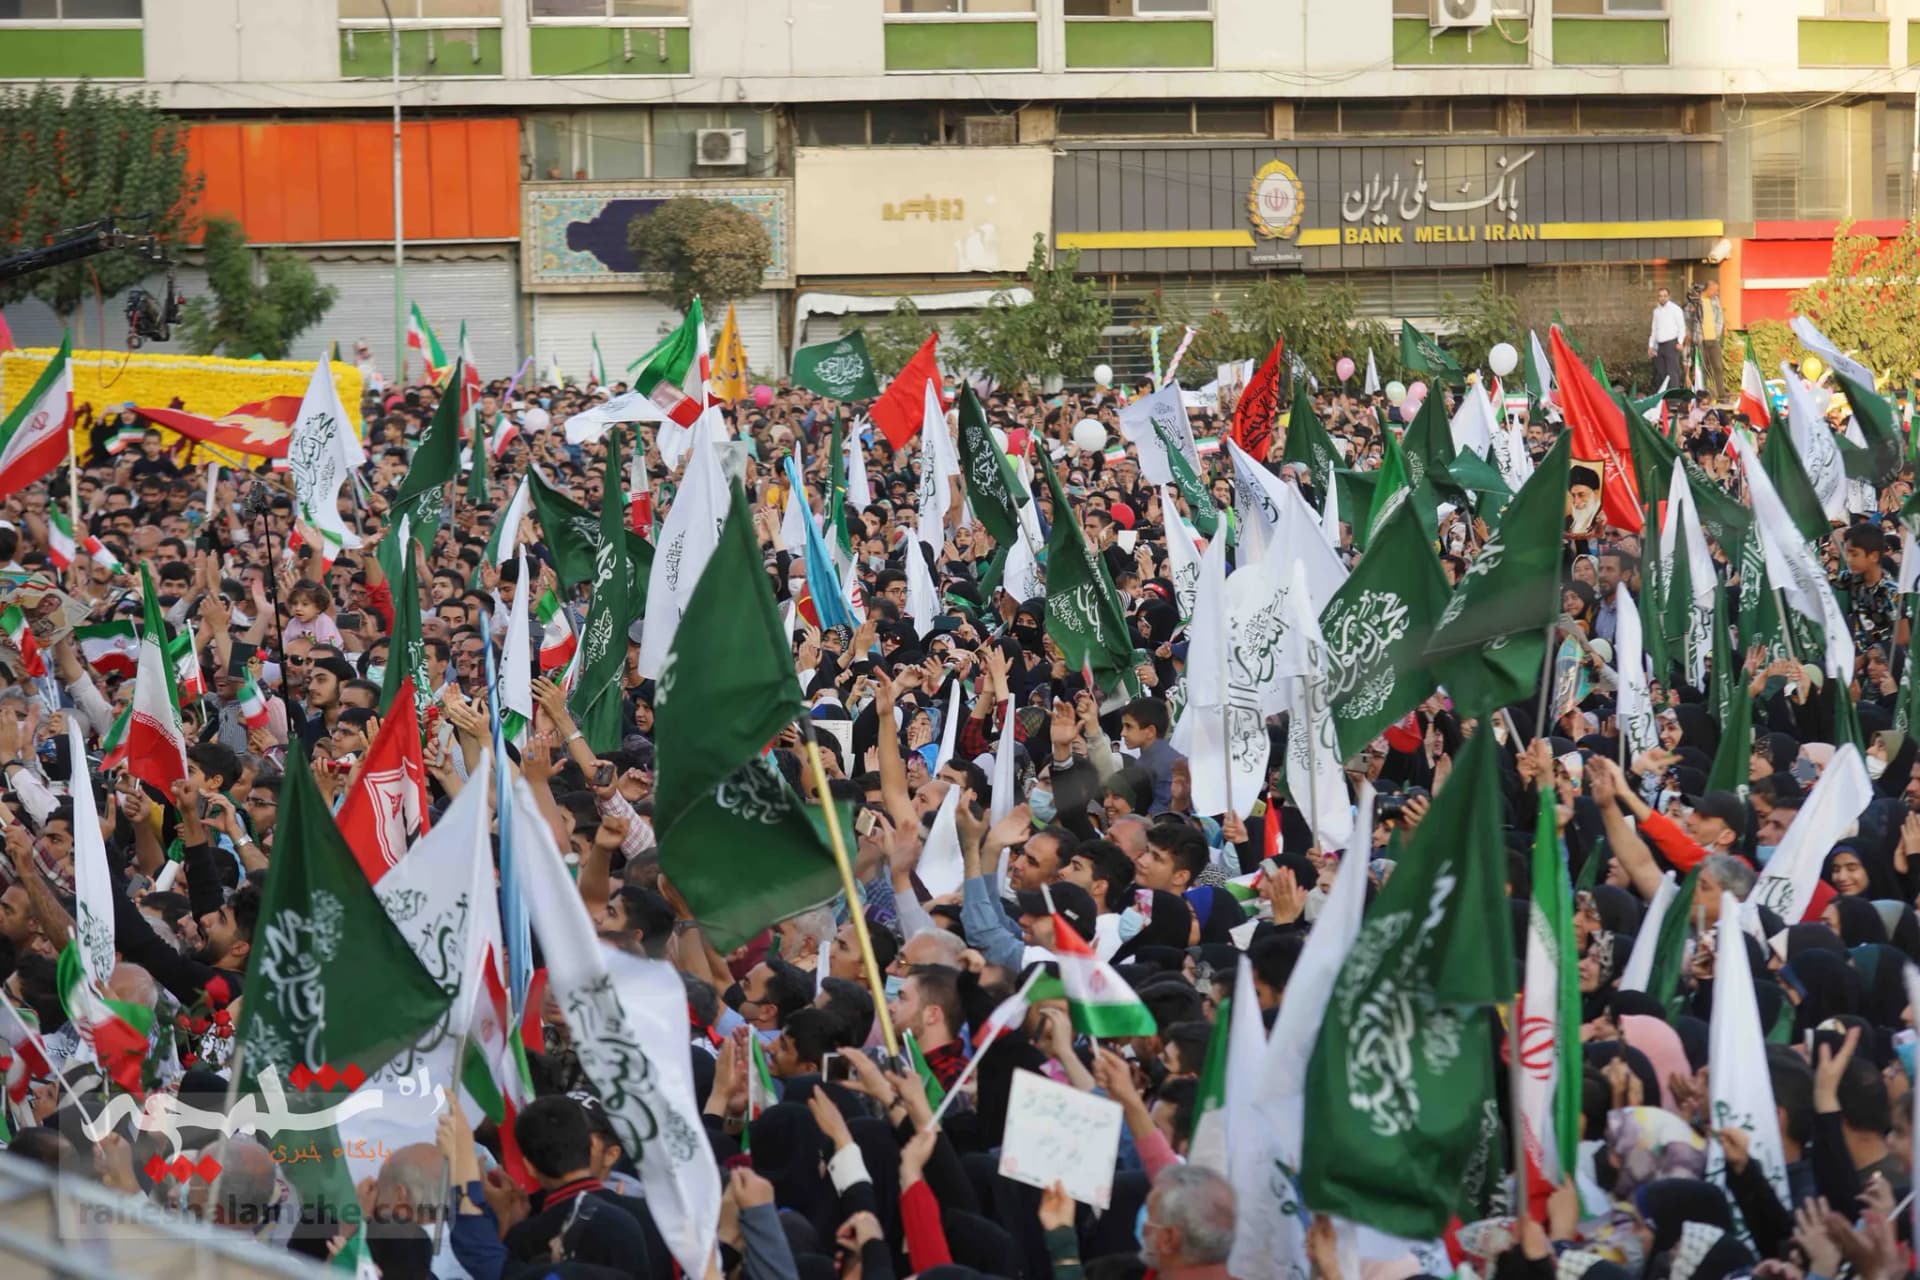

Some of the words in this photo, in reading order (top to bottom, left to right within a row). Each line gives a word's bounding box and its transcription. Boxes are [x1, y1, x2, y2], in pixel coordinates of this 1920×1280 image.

[1342, 172, 1400, 226] ایران
[1344, 225, 1403, 245] BANK
[1415, 224, 1476, 243] MELLI
[1484, 222, 1536, 241] IRAN
